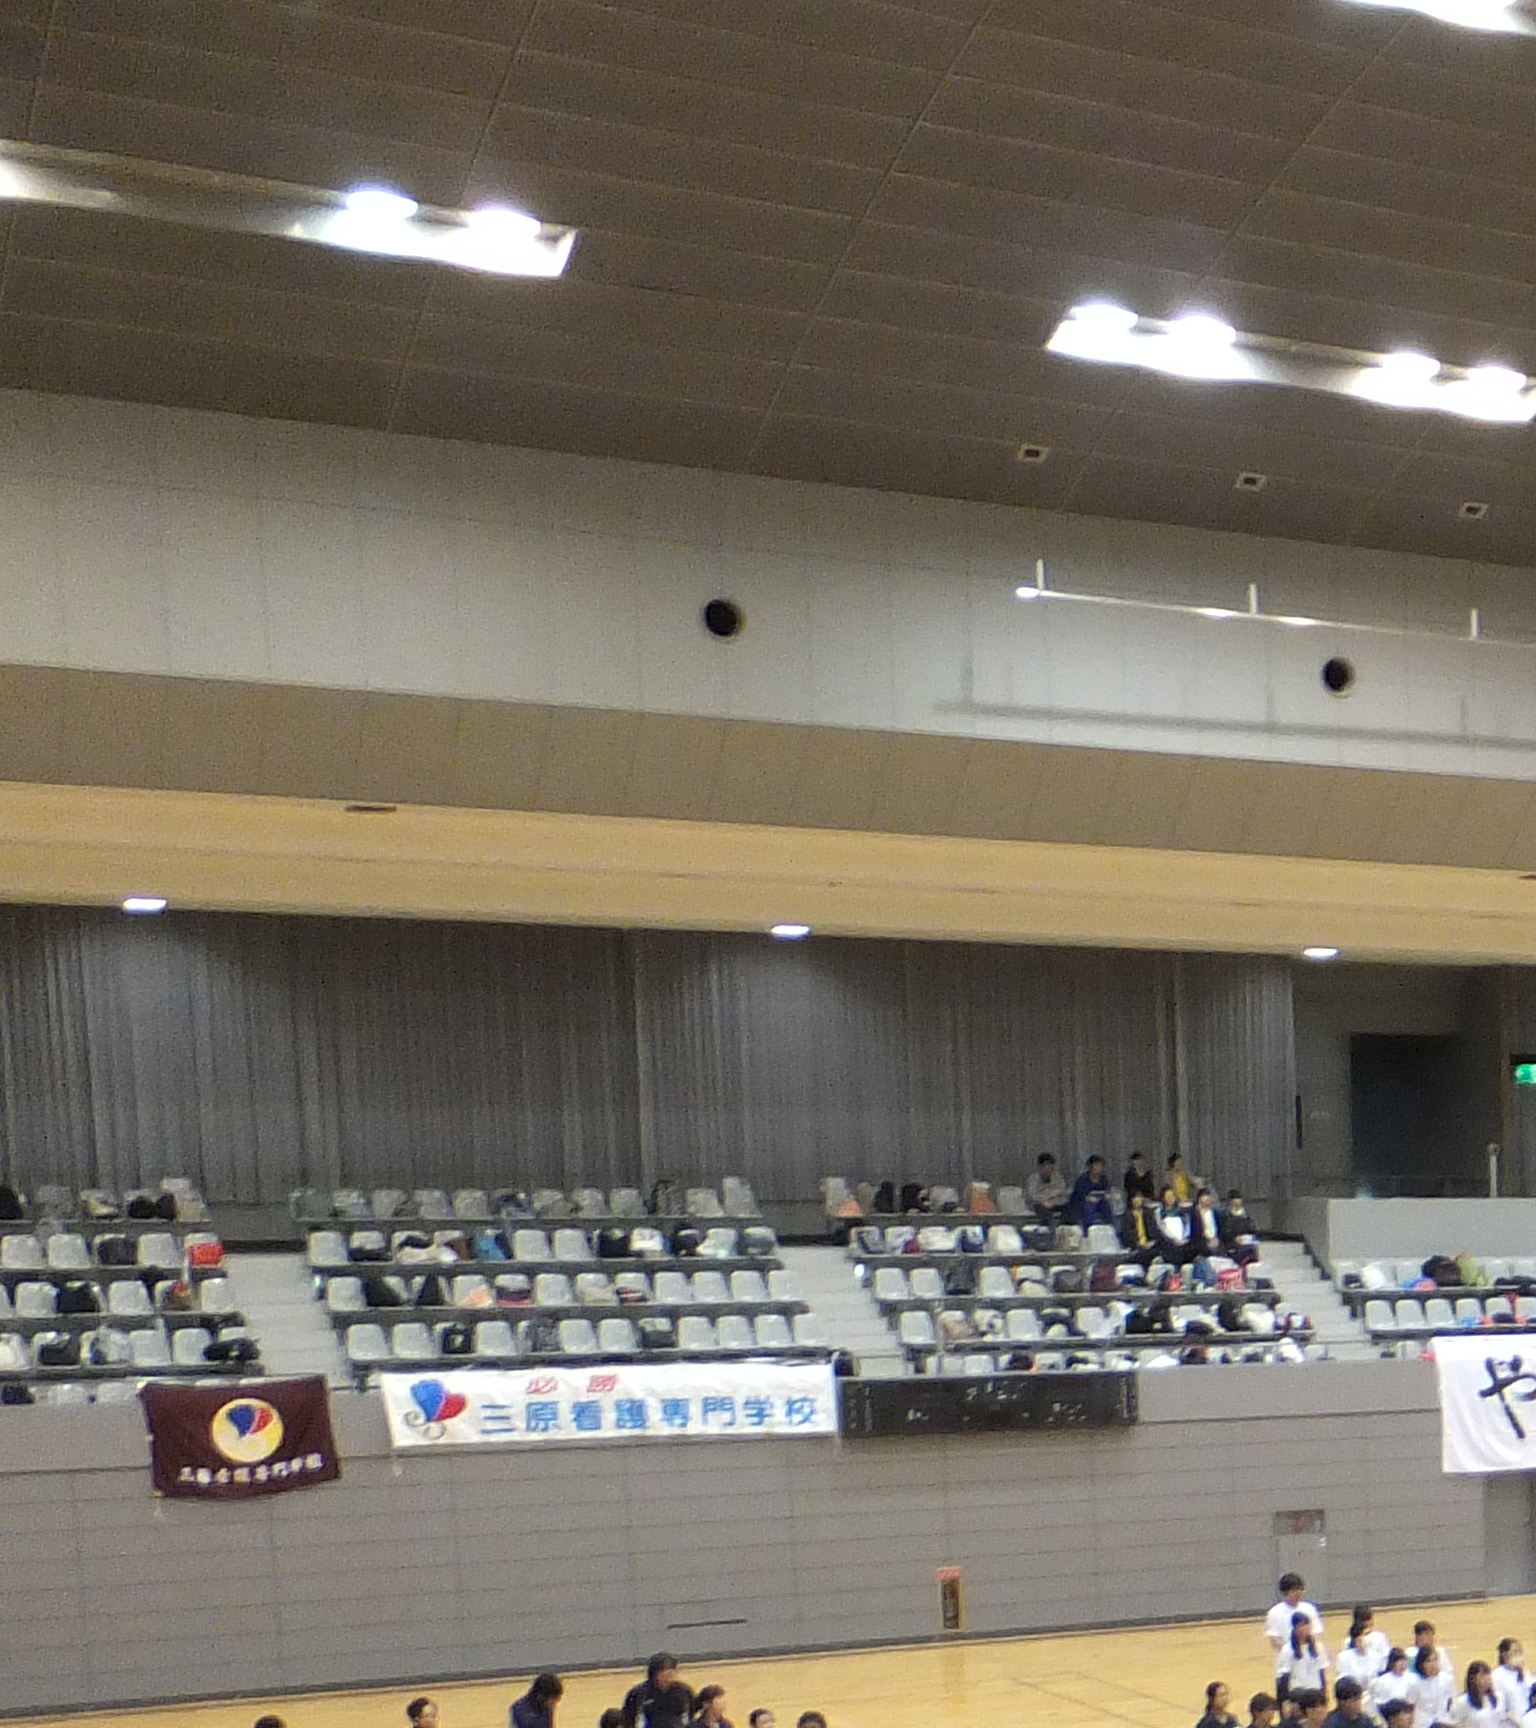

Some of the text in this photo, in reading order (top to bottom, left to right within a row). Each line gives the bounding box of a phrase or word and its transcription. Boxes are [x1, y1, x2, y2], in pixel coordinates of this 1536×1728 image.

[480, 1396, 820, 1435] 三原看護専門学校
